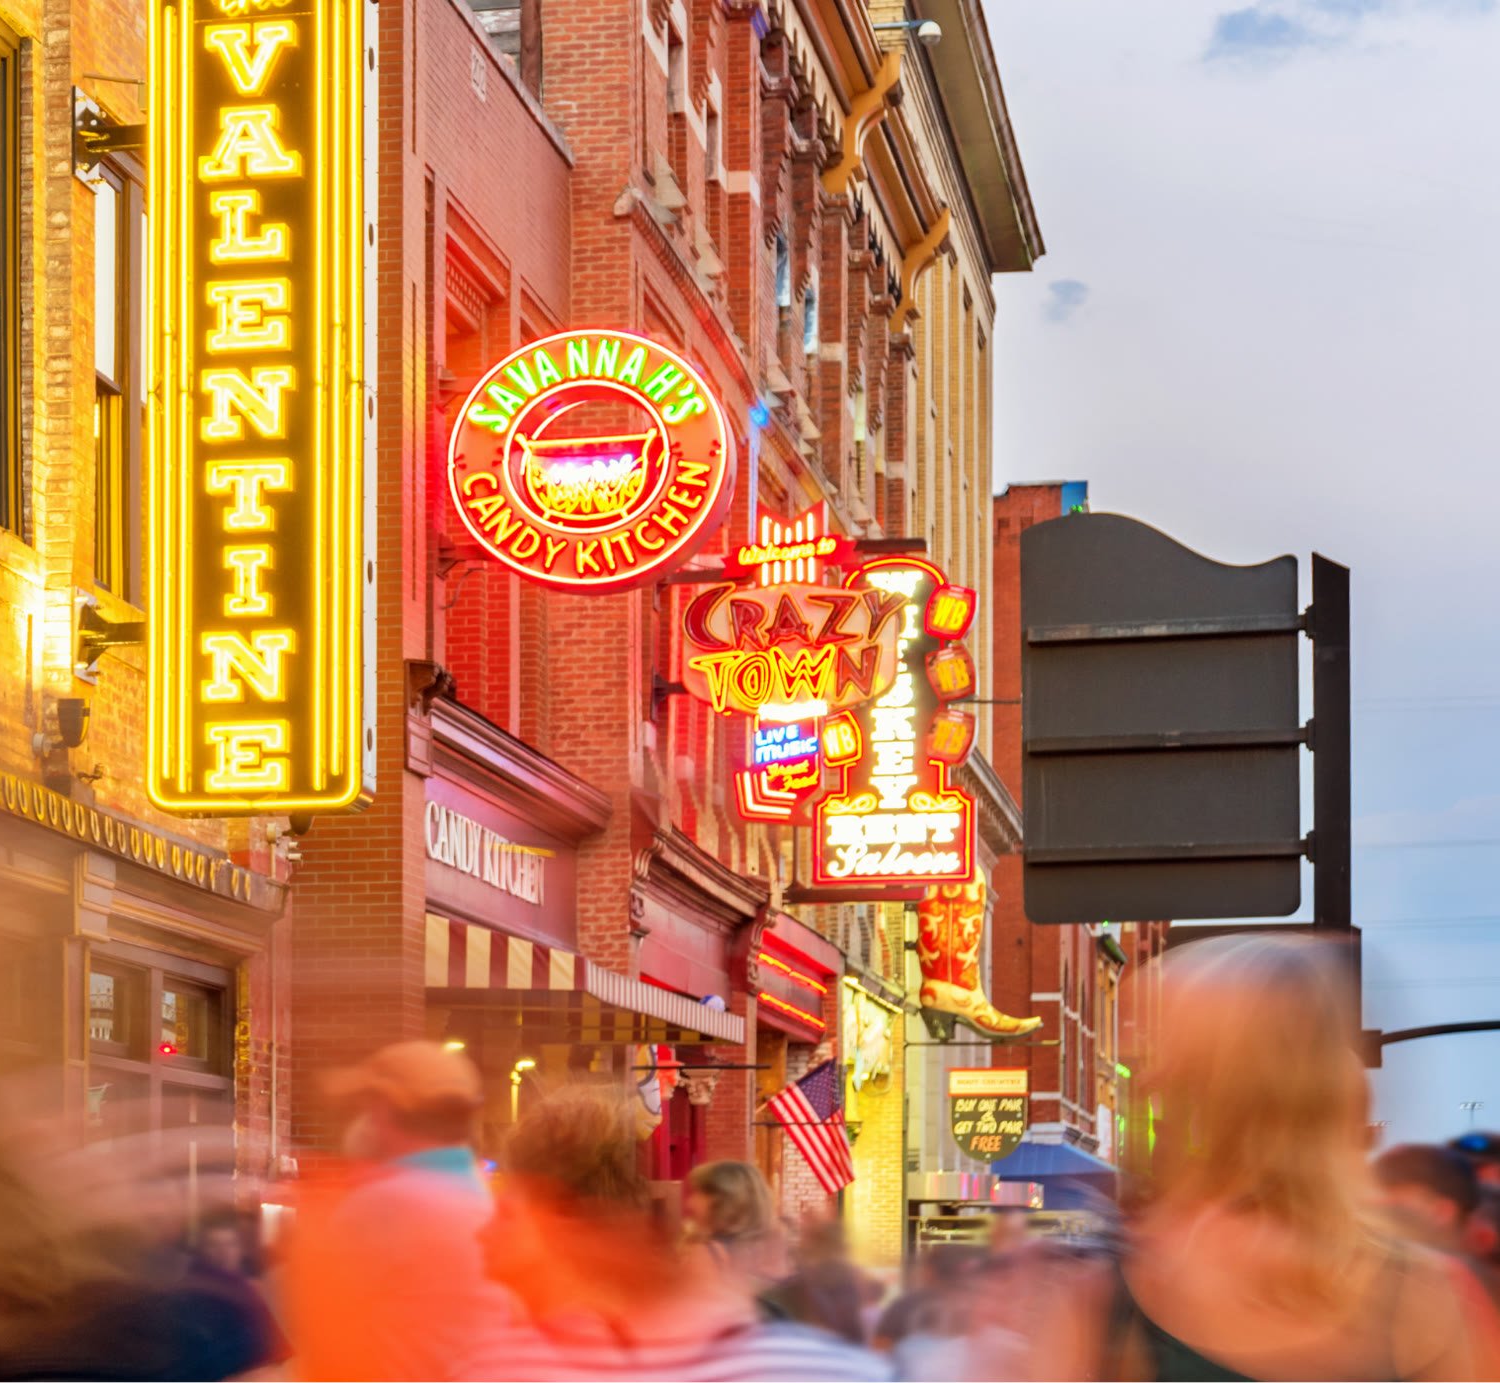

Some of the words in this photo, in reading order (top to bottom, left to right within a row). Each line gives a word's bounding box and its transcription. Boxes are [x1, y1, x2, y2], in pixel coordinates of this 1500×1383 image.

[467, 338, 707, 433] SAVANNAH'S
[198, 20, 303, 793] VALENTINE
[464, 472, 567, 569] CANDY
[575, 460, 711, 574] KITCHEN
[738, 541, 815, 566] Welcome
[816, 537, 837, 555] to
[684, 582, 910, 652] CRAZY
[932, 594, 968, 630] WB
[689, 643, 882, 712] TOWN
[755, 724, 799, 746] LIVE
[822, 723, 857, 759] WB
[826, 812, 960, 846] BENT
[425, 800, 483, 878] CANDY
[483, 828, 545, 906] KITCHEN
[826, 843, 960, 877] Saloon
[955, 1098, 978, 1112] BUY
[978, 1098, 998, 1112] ONE
[998, 1098, 1023, 1112] PAIR
[954, 1121, 974, 1135] GET
[975, 1120, 997, 1134] TWO
[998, 1121, 1023, 1135] PAIR
[970, 1135, 1002, 1152] FREE
